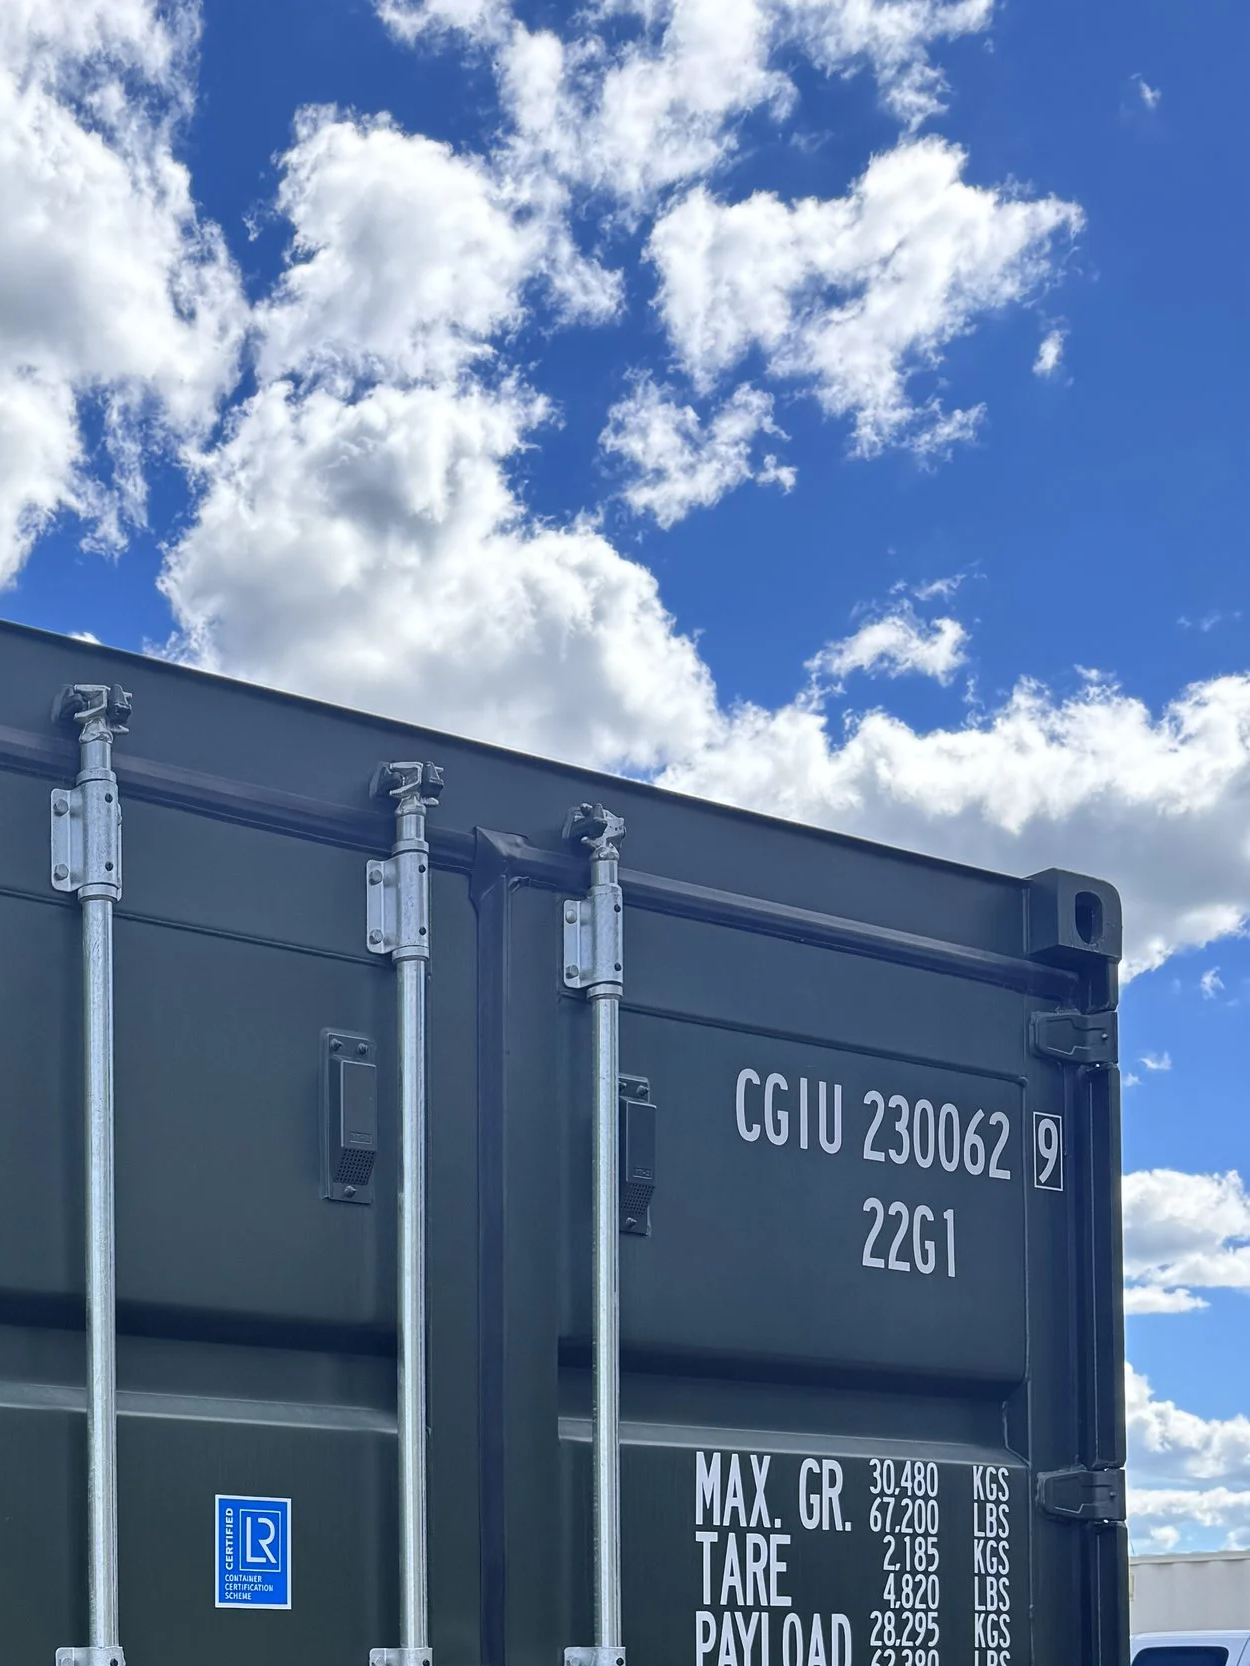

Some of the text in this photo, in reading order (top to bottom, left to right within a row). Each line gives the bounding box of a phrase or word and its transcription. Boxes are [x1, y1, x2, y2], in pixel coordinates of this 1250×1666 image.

[736, 1068, 1060, 1185] CGIU 230062 9
[861, 1197, 957, 1278] 22G1
[695, 1451, 1010, 1532] MAX. GR. 30,480 KGS
[225, 1507, 234, 1571] CERTIFIED
[246, 1516, 278, 1564] LR
[869, 1497, 1010, 1539] 67,200 LBS
[225, 1574, 263, 1583] CONTAINER
[225, 1583, 274, 1592] CERTIFICATION
[695, 1531, 1011, 1607] TARE 2,185 KGS
[225, 1592, 252, 1600] SCHEME
[883, 1574, 1011, 1612] 4,820 LBS
[869, 1611, 940, 1648] 28,295
[973, 1613, 1011, 1649] KGS
